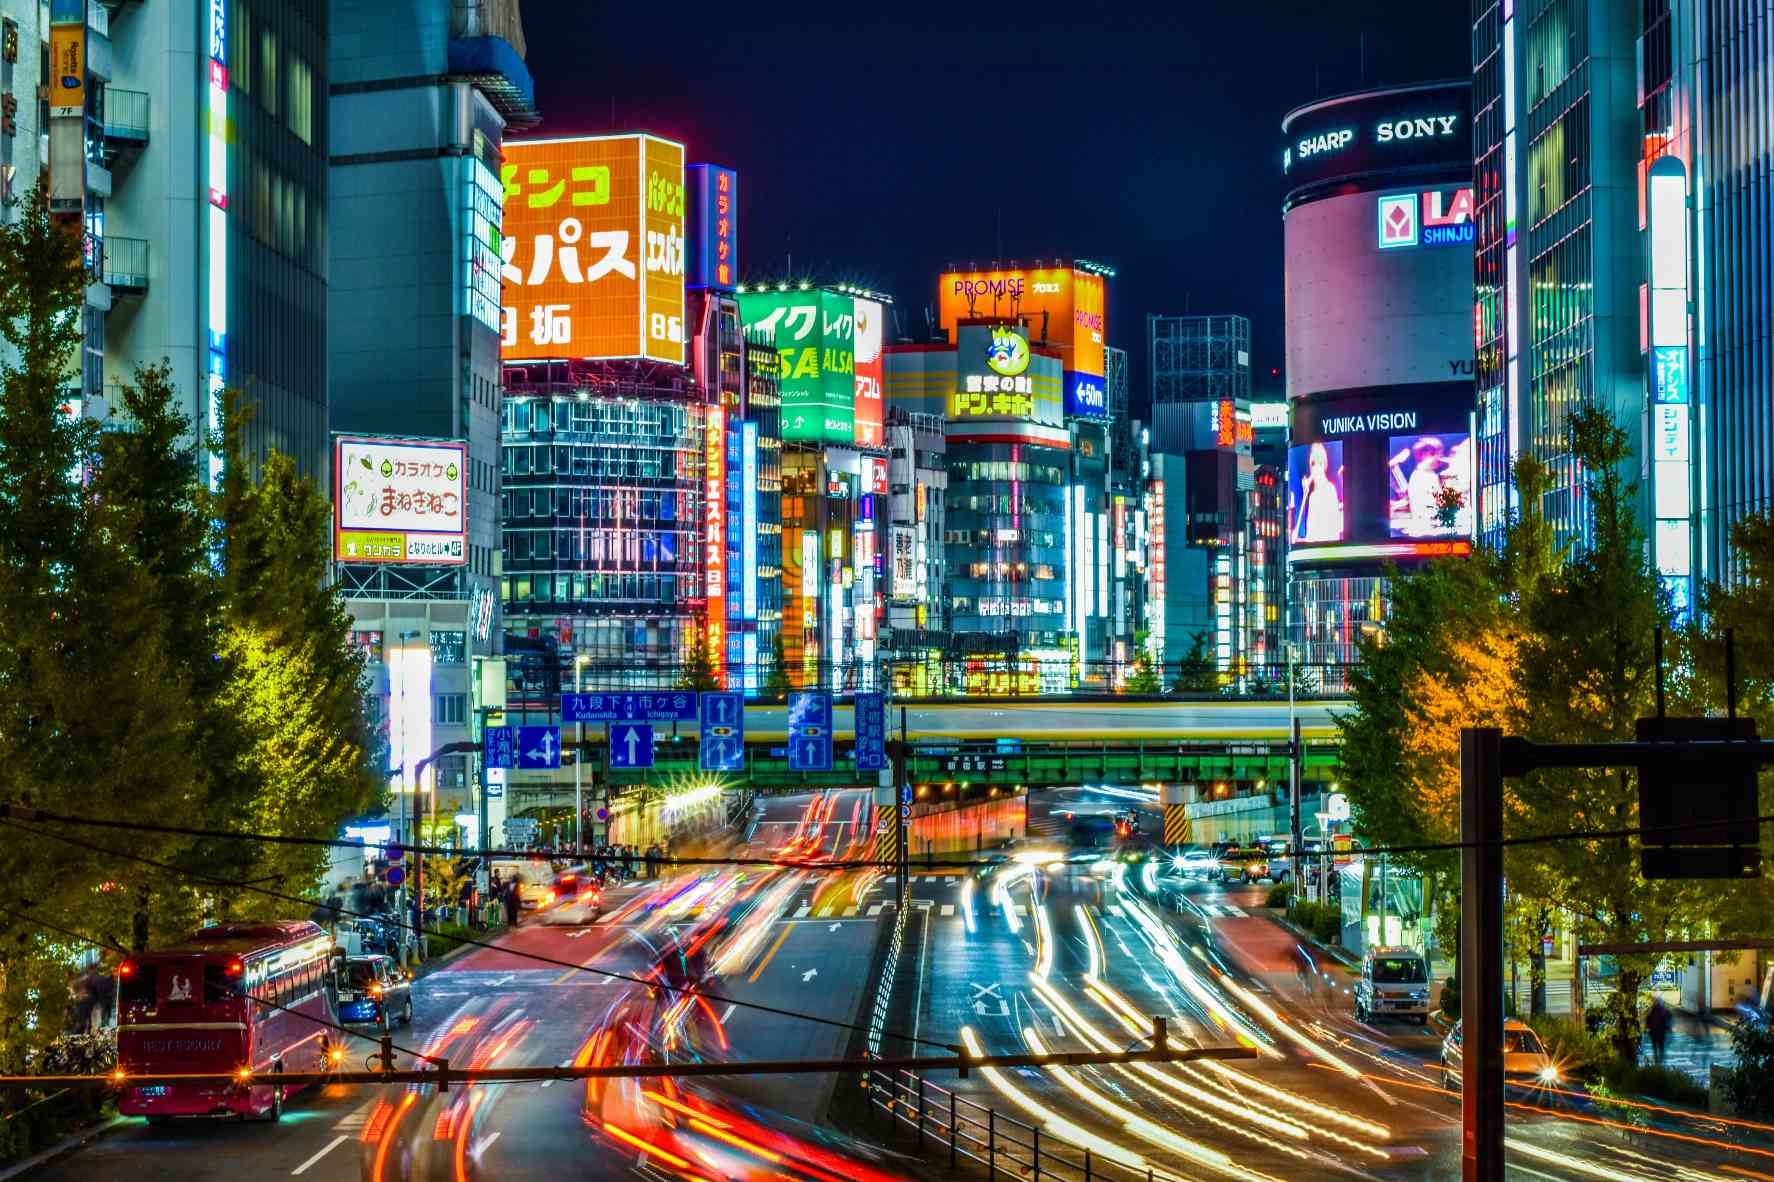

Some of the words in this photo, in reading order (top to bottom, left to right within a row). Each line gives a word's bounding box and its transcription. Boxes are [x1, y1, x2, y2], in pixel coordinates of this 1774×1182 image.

[1377, 116, 1456, 142] SONY
[1299, 130, 1353, 158] SHARP
[954, 279, 1025, 296] PROMISE
[823, 310, 853, 341] レイク
[1075, 309, 1102, 331] PROMISE
[822, 348, 854, 375] ALSA
[855, 375, 881, 400] アコム
[1085, 383, 1103, 408] 50m
[1322, 415, 1366, 435] YUNIKA
[1366, 412, 1417, 431] VISION
[394, 460, 445, 478] カラオケ
[380, 485, 457, 517] まねきねこ
[571, 696, 621, 711] 九段下
